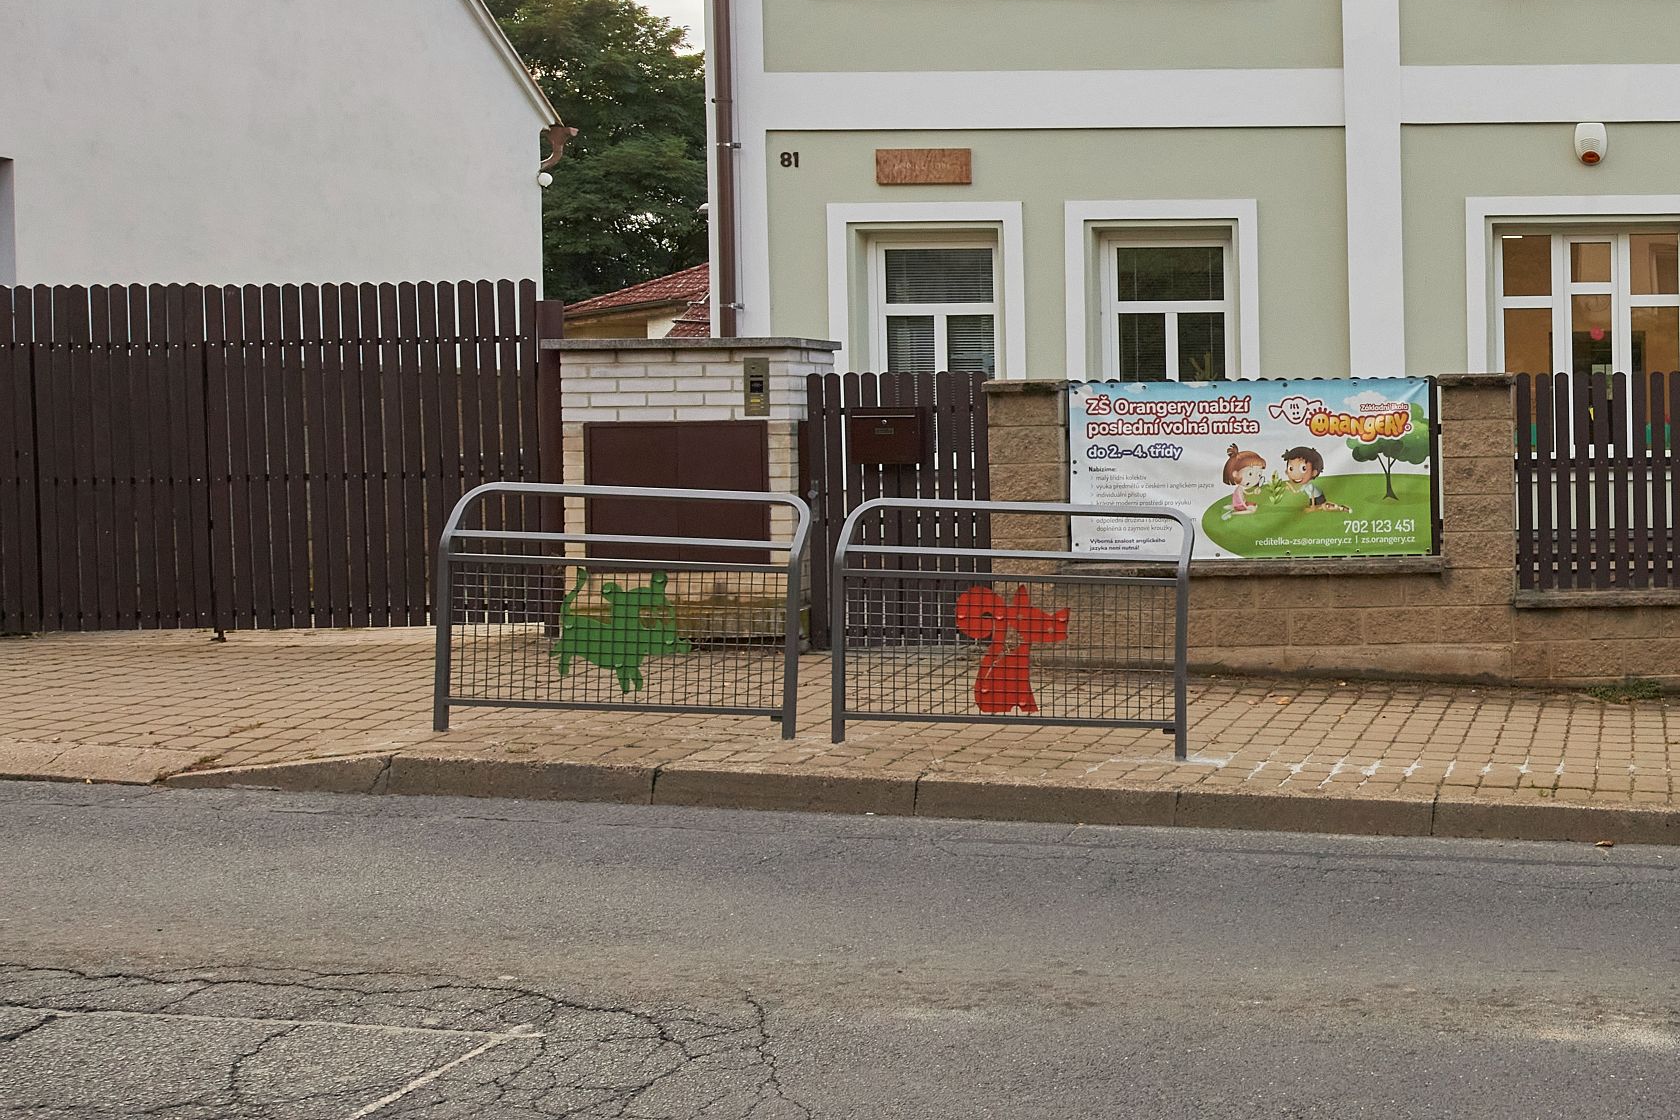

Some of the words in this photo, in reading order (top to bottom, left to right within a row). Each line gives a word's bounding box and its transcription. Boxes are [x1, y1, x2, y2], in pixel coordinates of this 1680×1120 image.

[780, 151, 799, 168] 81
[1086, 396, 1111, 415] ZŠ
[1114, 399, 1195, 418] Orangery
[1197, 396, 1251, 414] nabízí
[1360, 402, 1389, 412] Základní
[1087, 418, 1161, 438] poslední
[1162, 417, 1209, 435] volná
[1212, 417, 1260, 434] místa
[1087, 444, 1107, 459] do
[1149, 443, 1182, 459] třídy
[1344, 520, 1368, 533] 702
[1371, 520, 1391, 532] 123
[1394, 519, 1415, 532] 451
[1361, 535, 1416, 544] zs.orangery.cz
